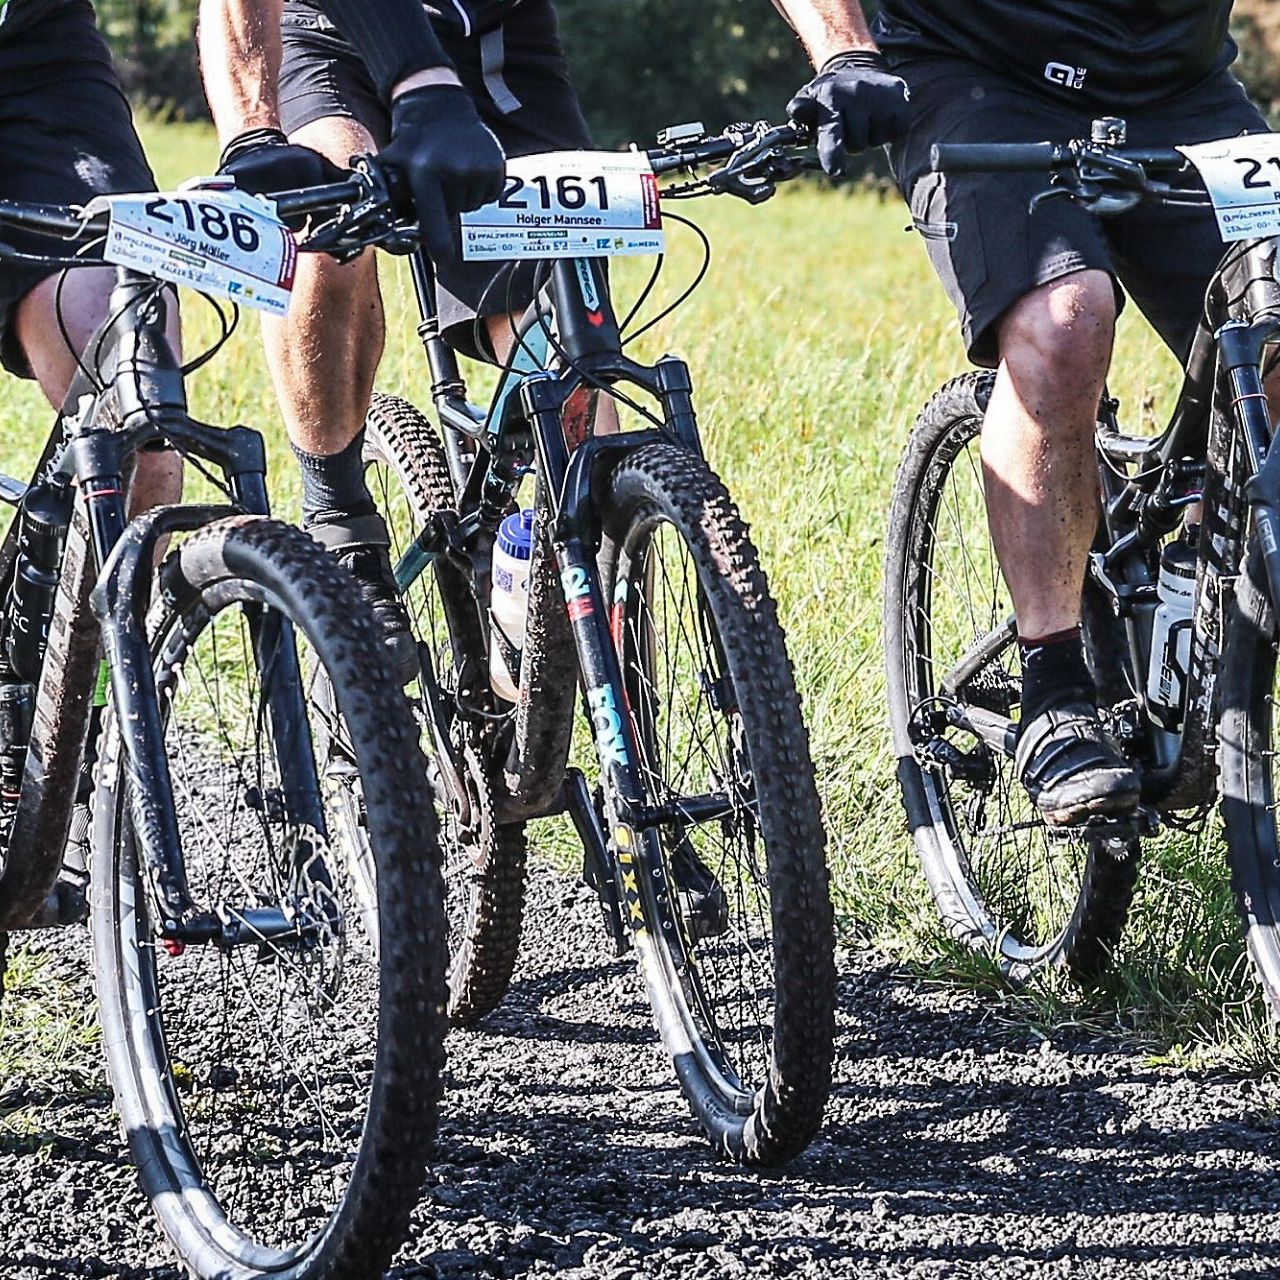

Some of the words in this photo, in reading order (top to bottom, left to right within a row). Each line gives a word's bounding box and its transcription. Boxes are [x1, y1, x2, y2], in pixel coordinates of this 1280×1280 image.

[498, 175, 610, 211] 2161
[144, 197, 260, 253] 2186
[516, 214, 551, 226] Holger
[554, 214, 602, 225] Mannsee
[174, 232, 197, 252] Jörg
[587, 682, 630, 772] FOX
